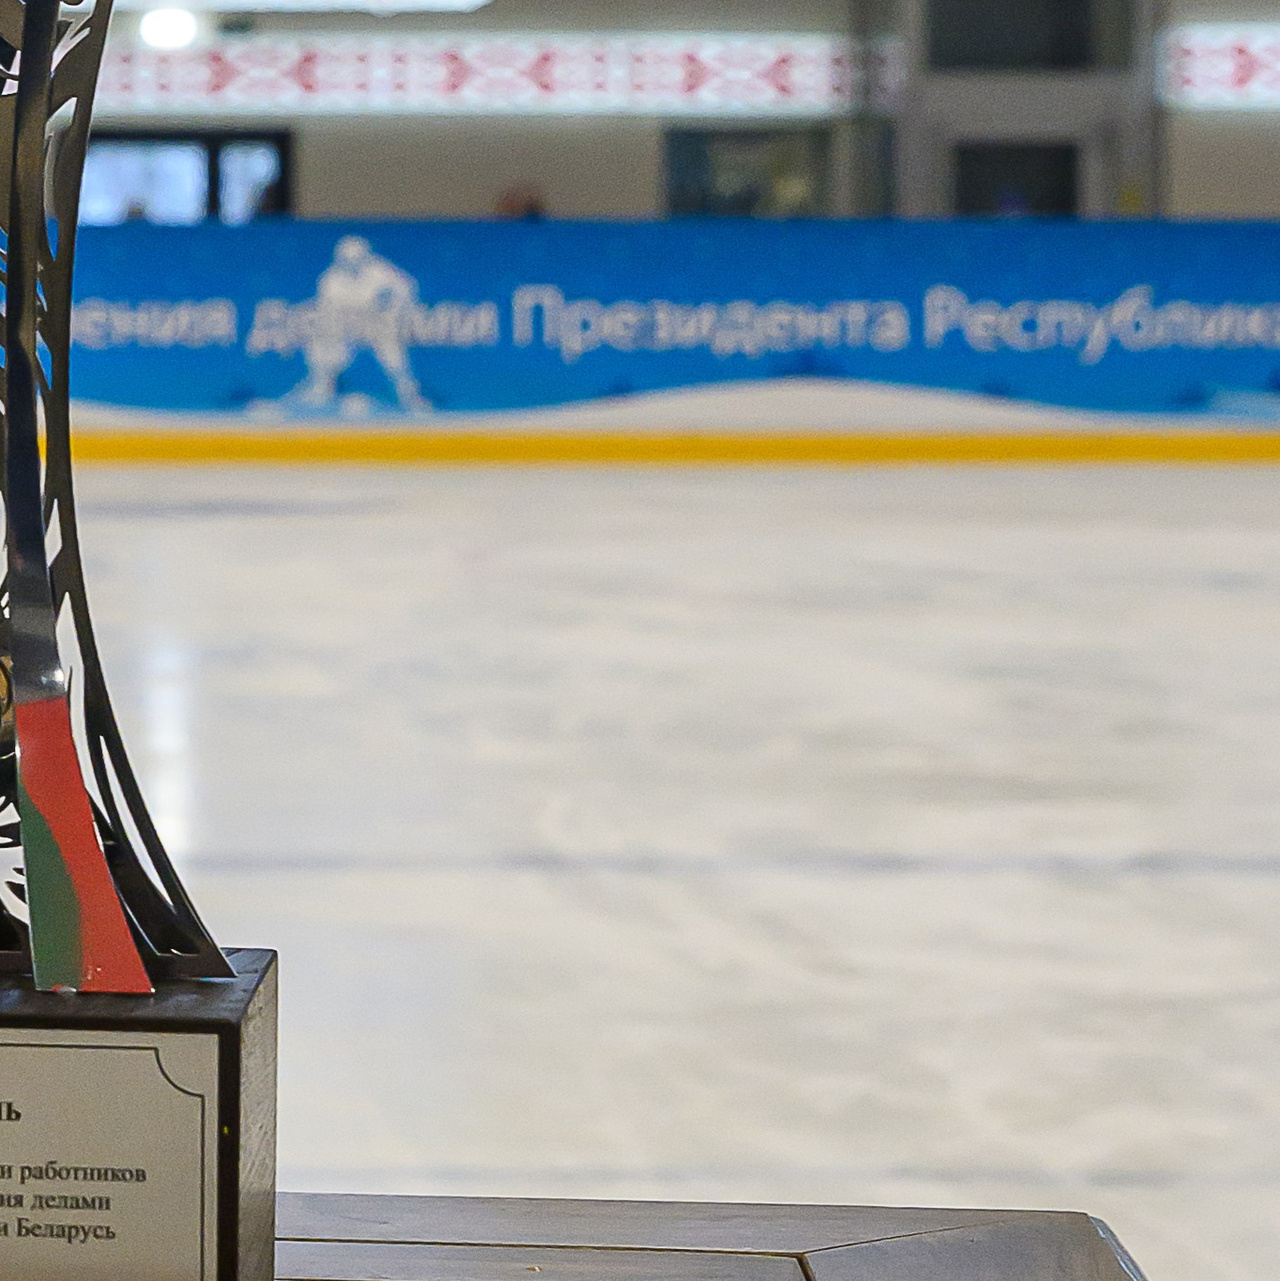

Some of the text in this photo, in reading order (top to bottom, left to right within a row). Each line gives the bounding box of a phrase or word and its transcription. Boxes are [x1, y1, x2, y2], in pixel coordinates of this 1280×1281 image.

[512, 283, 910, 363] Президента
[20, 1161, 147, 1184] работников
[30, 1192, 111, 1210] делами
[17, 1217, 116, 1243] Беларусь
